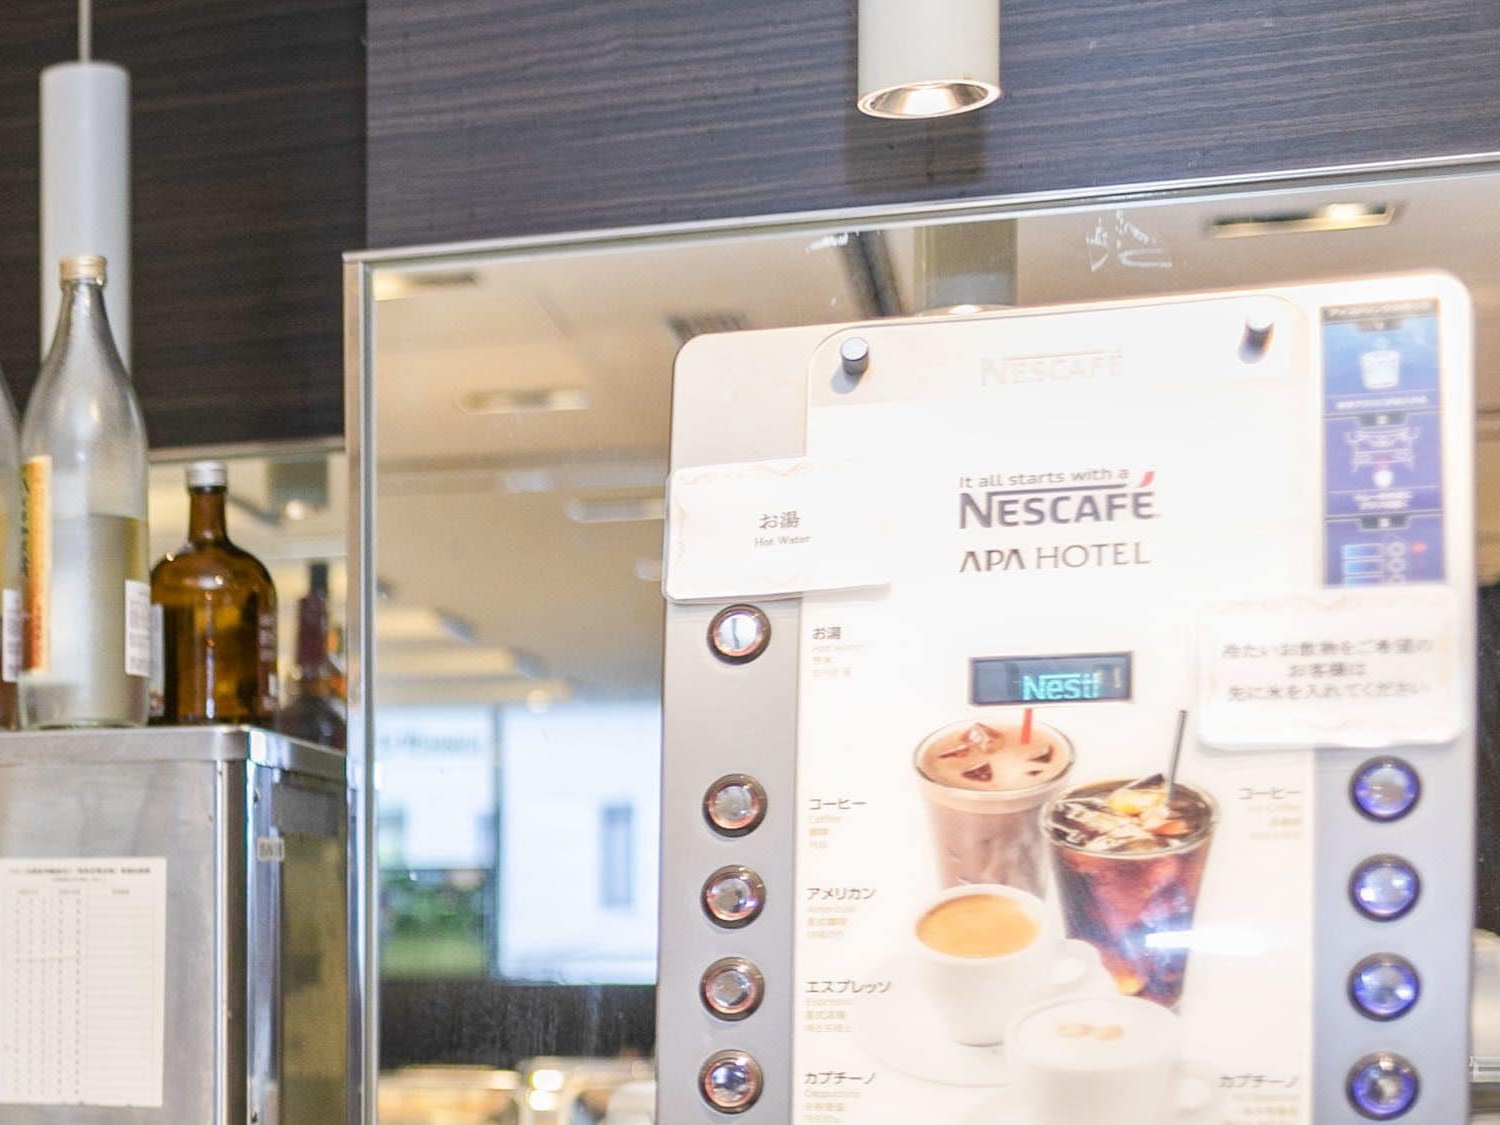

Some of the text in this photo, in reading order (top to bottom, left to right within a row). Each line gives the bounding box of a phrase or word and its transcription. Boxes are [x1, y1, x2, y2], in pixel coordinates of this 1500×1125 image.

[959, 466, 1131, 489] It all starts with a
[758, 511, 801, 530] お湯
[777, 534, 813, 547] Water
[959, 541, 1152, 574] APA HOTEL
[811, 626, 842, 641] お湯
[1237, 785, 1303, 801] コーヒー
[808, 798, 868, 811] コーヒー
[806, 887, 877, 901] アメリカン
[805, 979, 893, 994] エスプレッソ
[804, 1070, 877, 1085] カプチーノ
[1219, 1073, 1299, 1089] カプチーノ
